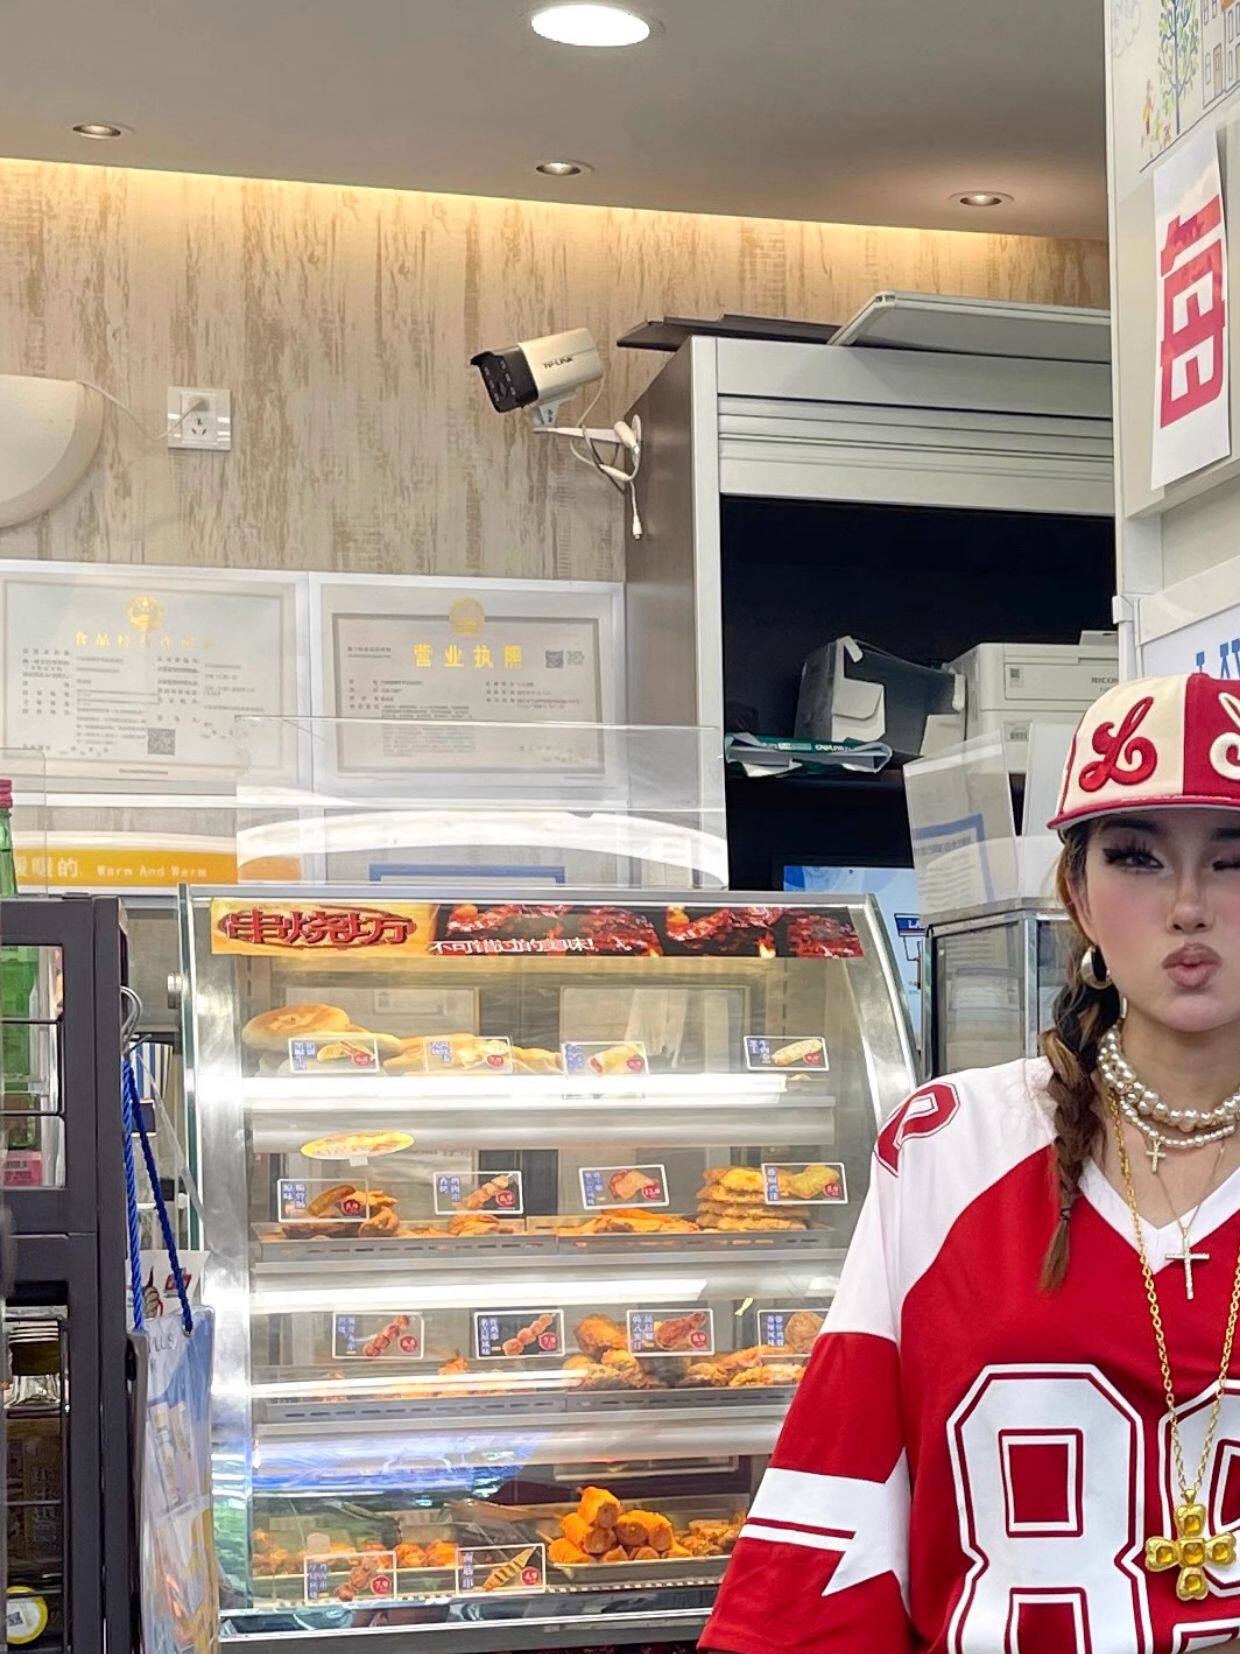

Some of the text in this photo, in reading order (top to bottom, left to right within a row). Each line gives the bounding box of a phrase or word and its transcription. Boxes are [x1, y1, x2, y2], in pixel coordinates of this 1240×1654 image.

[1160, 194, 1227, 428] 每
[413, 643, 522, 669] 营业执照
[97, 864, 132, 876] Warm
[139, 862, 164, 877] And
[172, 865, 207, 877] Warm
[226, 907, 414, 946] 串烧坊
